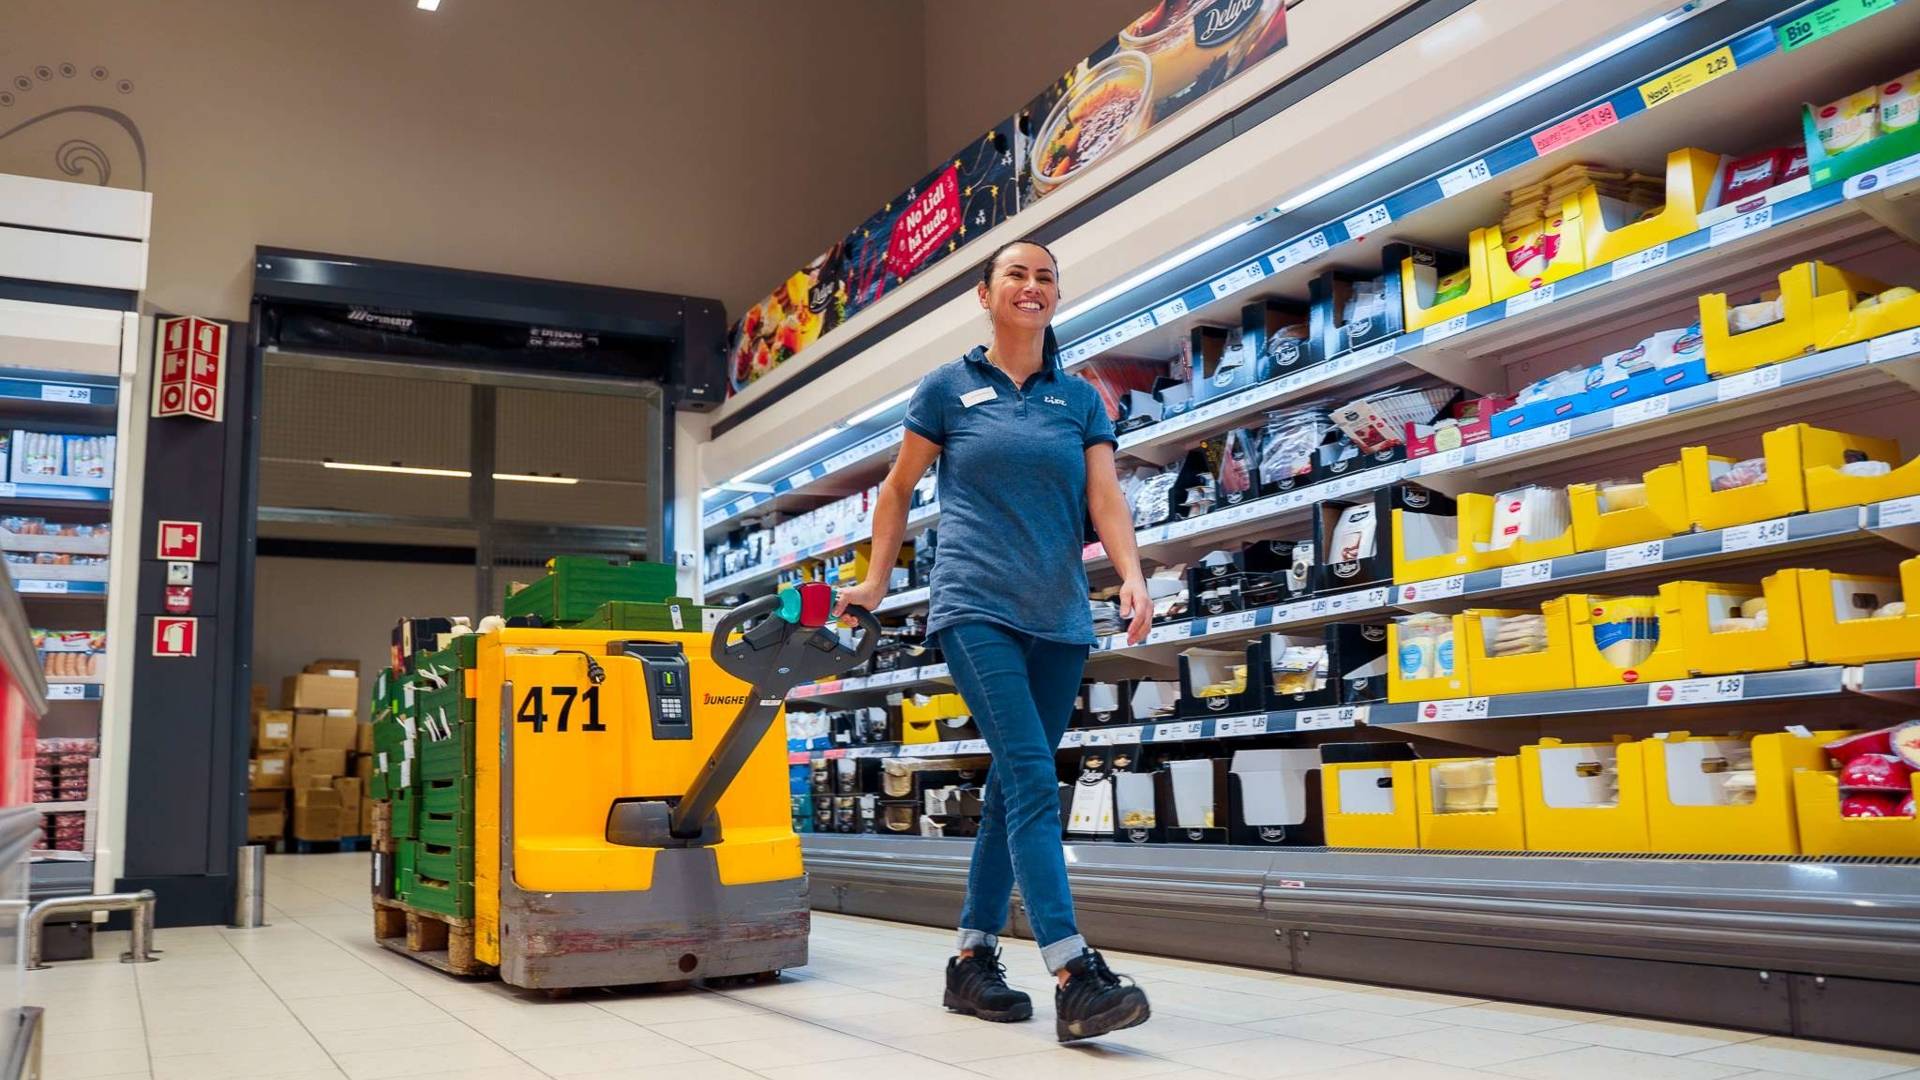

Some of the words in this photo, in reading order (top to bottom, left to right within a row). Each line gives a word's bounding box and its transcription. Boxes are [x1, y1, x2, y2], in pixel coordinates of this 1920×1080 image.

[1786, 22, 1812, 40] Bio
[1647, 82, 1673, 101] Novo!
[906, 210, 922, 232] No
[923, 183, 945, 216] Lidl
[908, 229, 922, 252] há
[922, 208, 948, 238] tudo
[517, 686, 606, 733] 471
